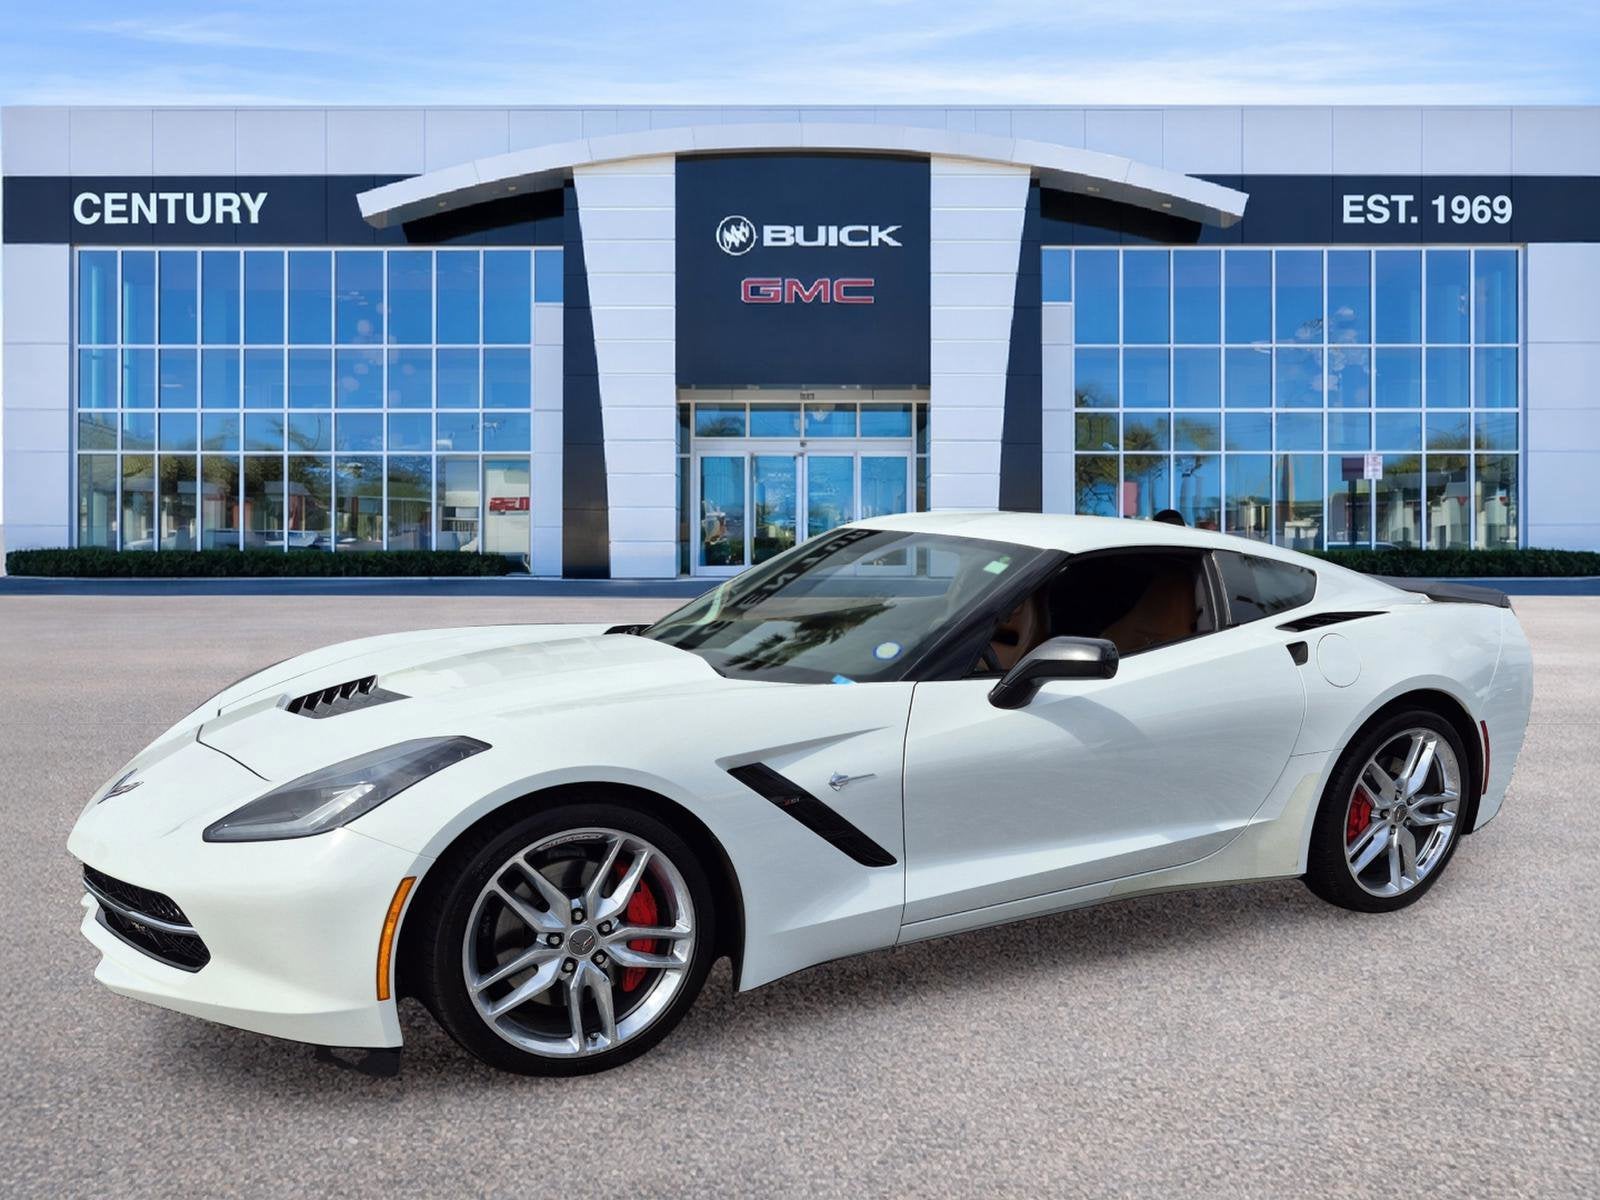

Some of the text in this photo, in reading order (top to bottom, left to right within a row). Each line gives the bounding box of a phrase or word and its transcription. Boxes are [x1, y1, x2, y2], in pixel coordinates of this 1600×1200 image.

[73, 192, 268, 225] CENTURY
[1342, 194, 1513, 224] EST. 1969
[763, 225, 902, 247] BUICK
[741, 277, 875, 304] GMC
